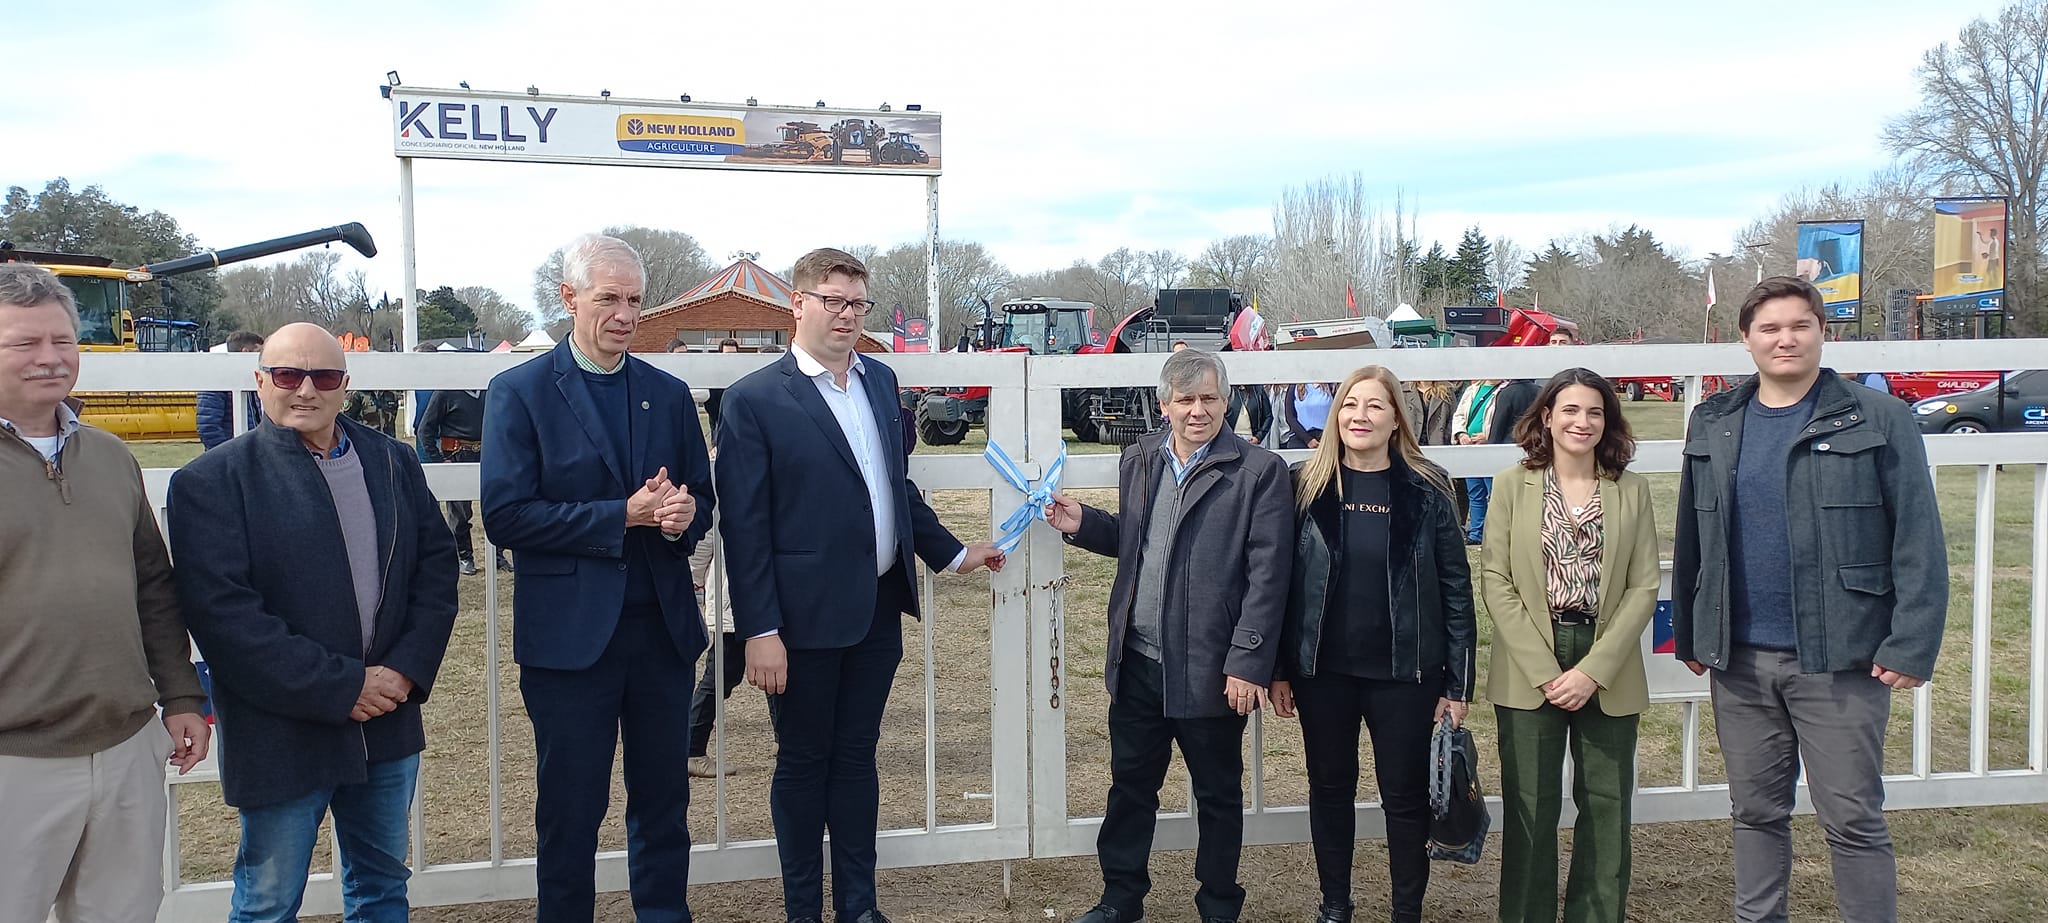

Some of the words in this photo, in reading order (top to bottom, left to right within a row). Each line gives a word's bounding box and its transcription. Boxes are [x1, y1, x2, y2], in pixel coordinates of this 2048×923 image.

[400, 101, 558, 143] KELLY
[647, 124, 675, 134] NEW
[679, 125, 735, 137] HOLLAND
[401, 141, 453, 149] CONCESIONARIO
[647, 142, 715, 153] AGRICULTURE
